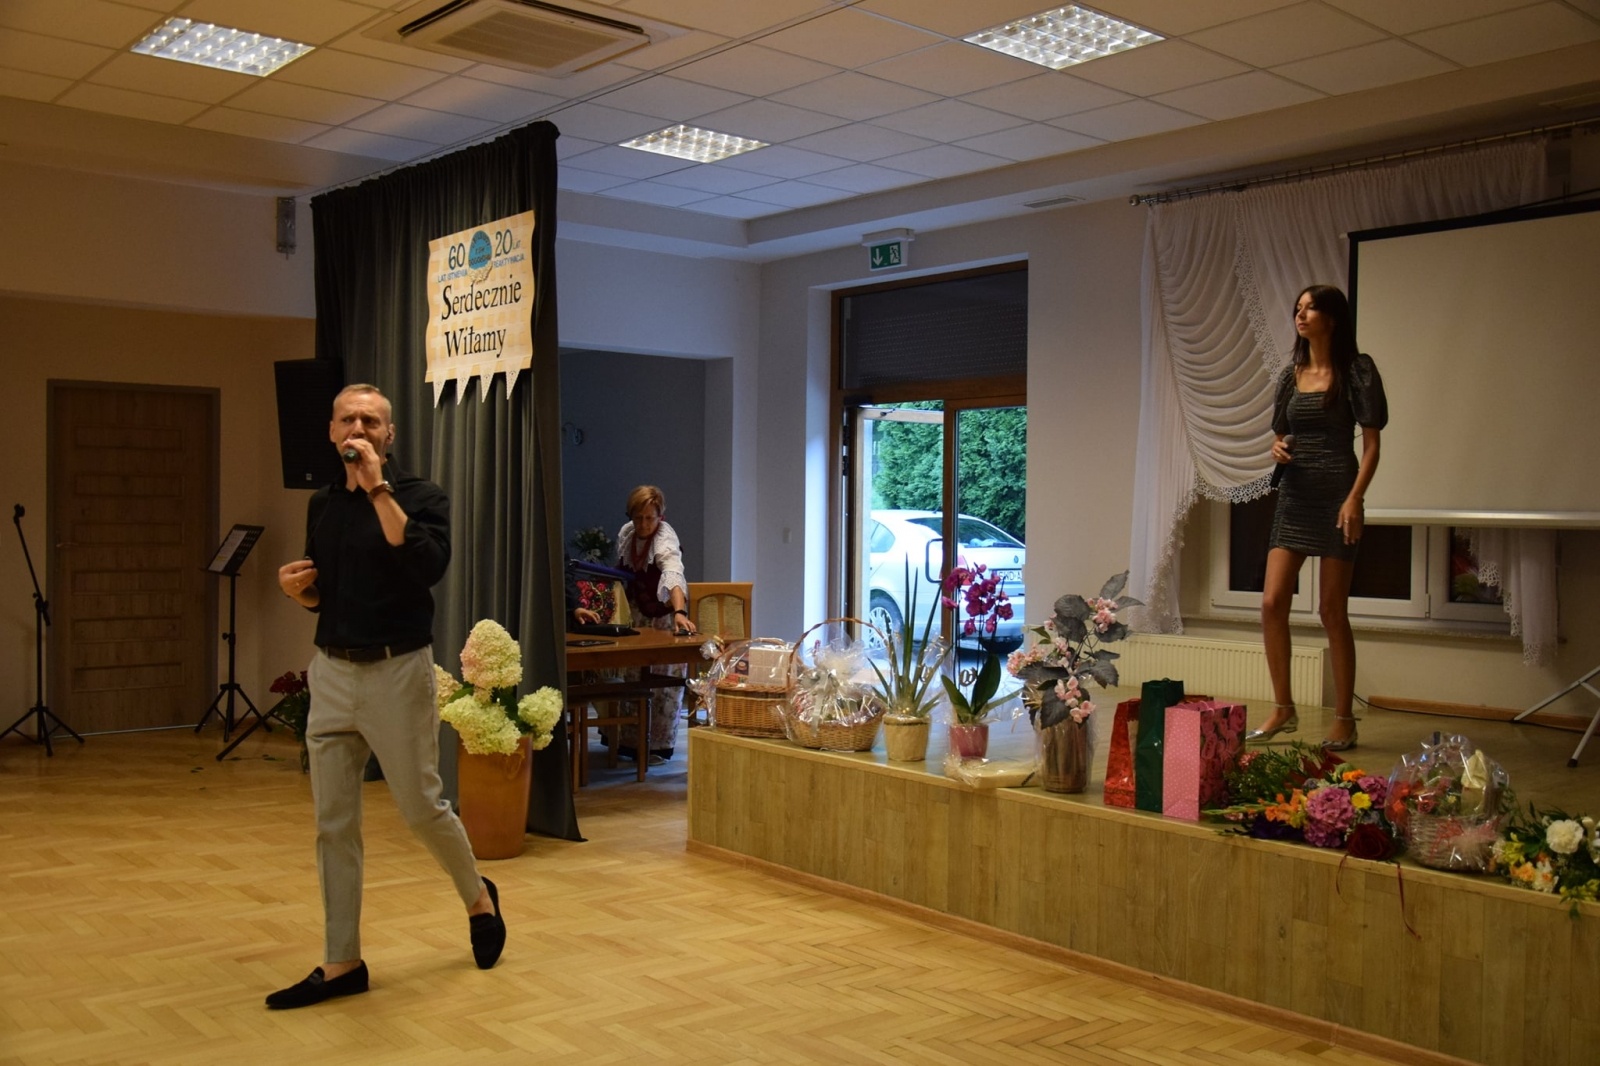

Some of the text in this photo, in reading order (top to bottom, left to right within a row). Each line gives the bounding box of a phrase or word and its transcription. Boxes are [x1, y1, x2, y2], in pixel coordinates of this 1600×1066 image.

[448, 242, 466, 270] 60
[495, 229, 513, 258] 20
[441, 274, 522, 321] Serdecznie
[444, 325, 507, 358] Witamy
